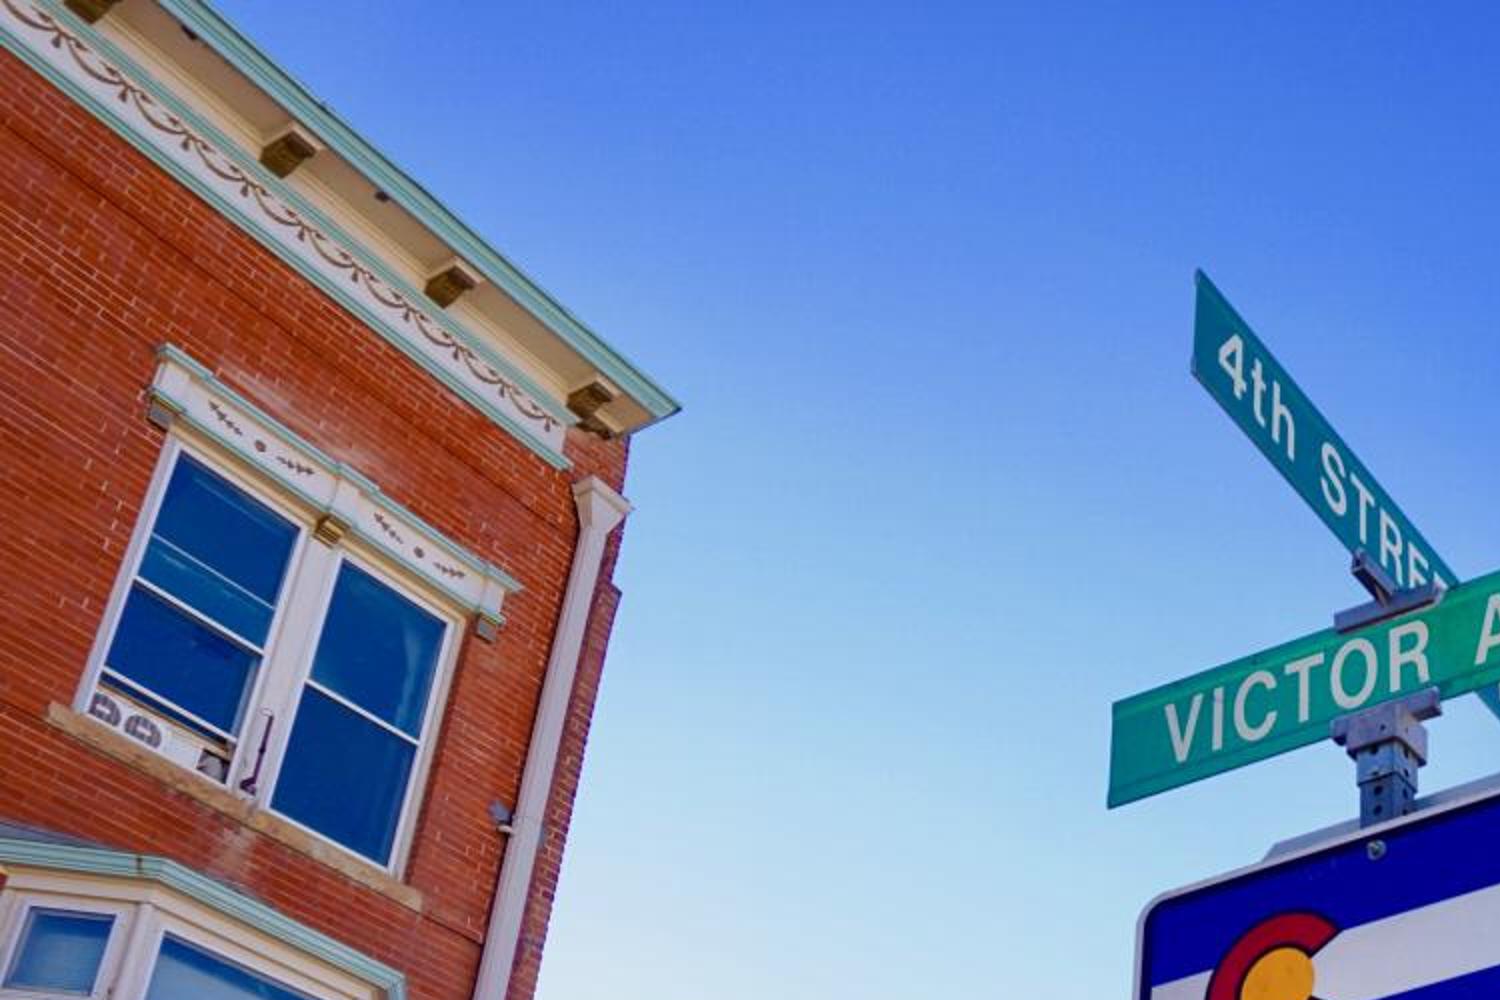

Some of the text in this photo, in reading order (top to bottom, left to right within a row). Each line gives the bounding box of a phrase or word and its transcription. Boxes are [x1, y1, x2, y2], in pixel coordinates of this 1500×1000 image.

[1217, 334, 1296, 460] 4th
[1320, 442, 1451, 590] STRE
[1164, 619, 1431, 764] VICTOR
